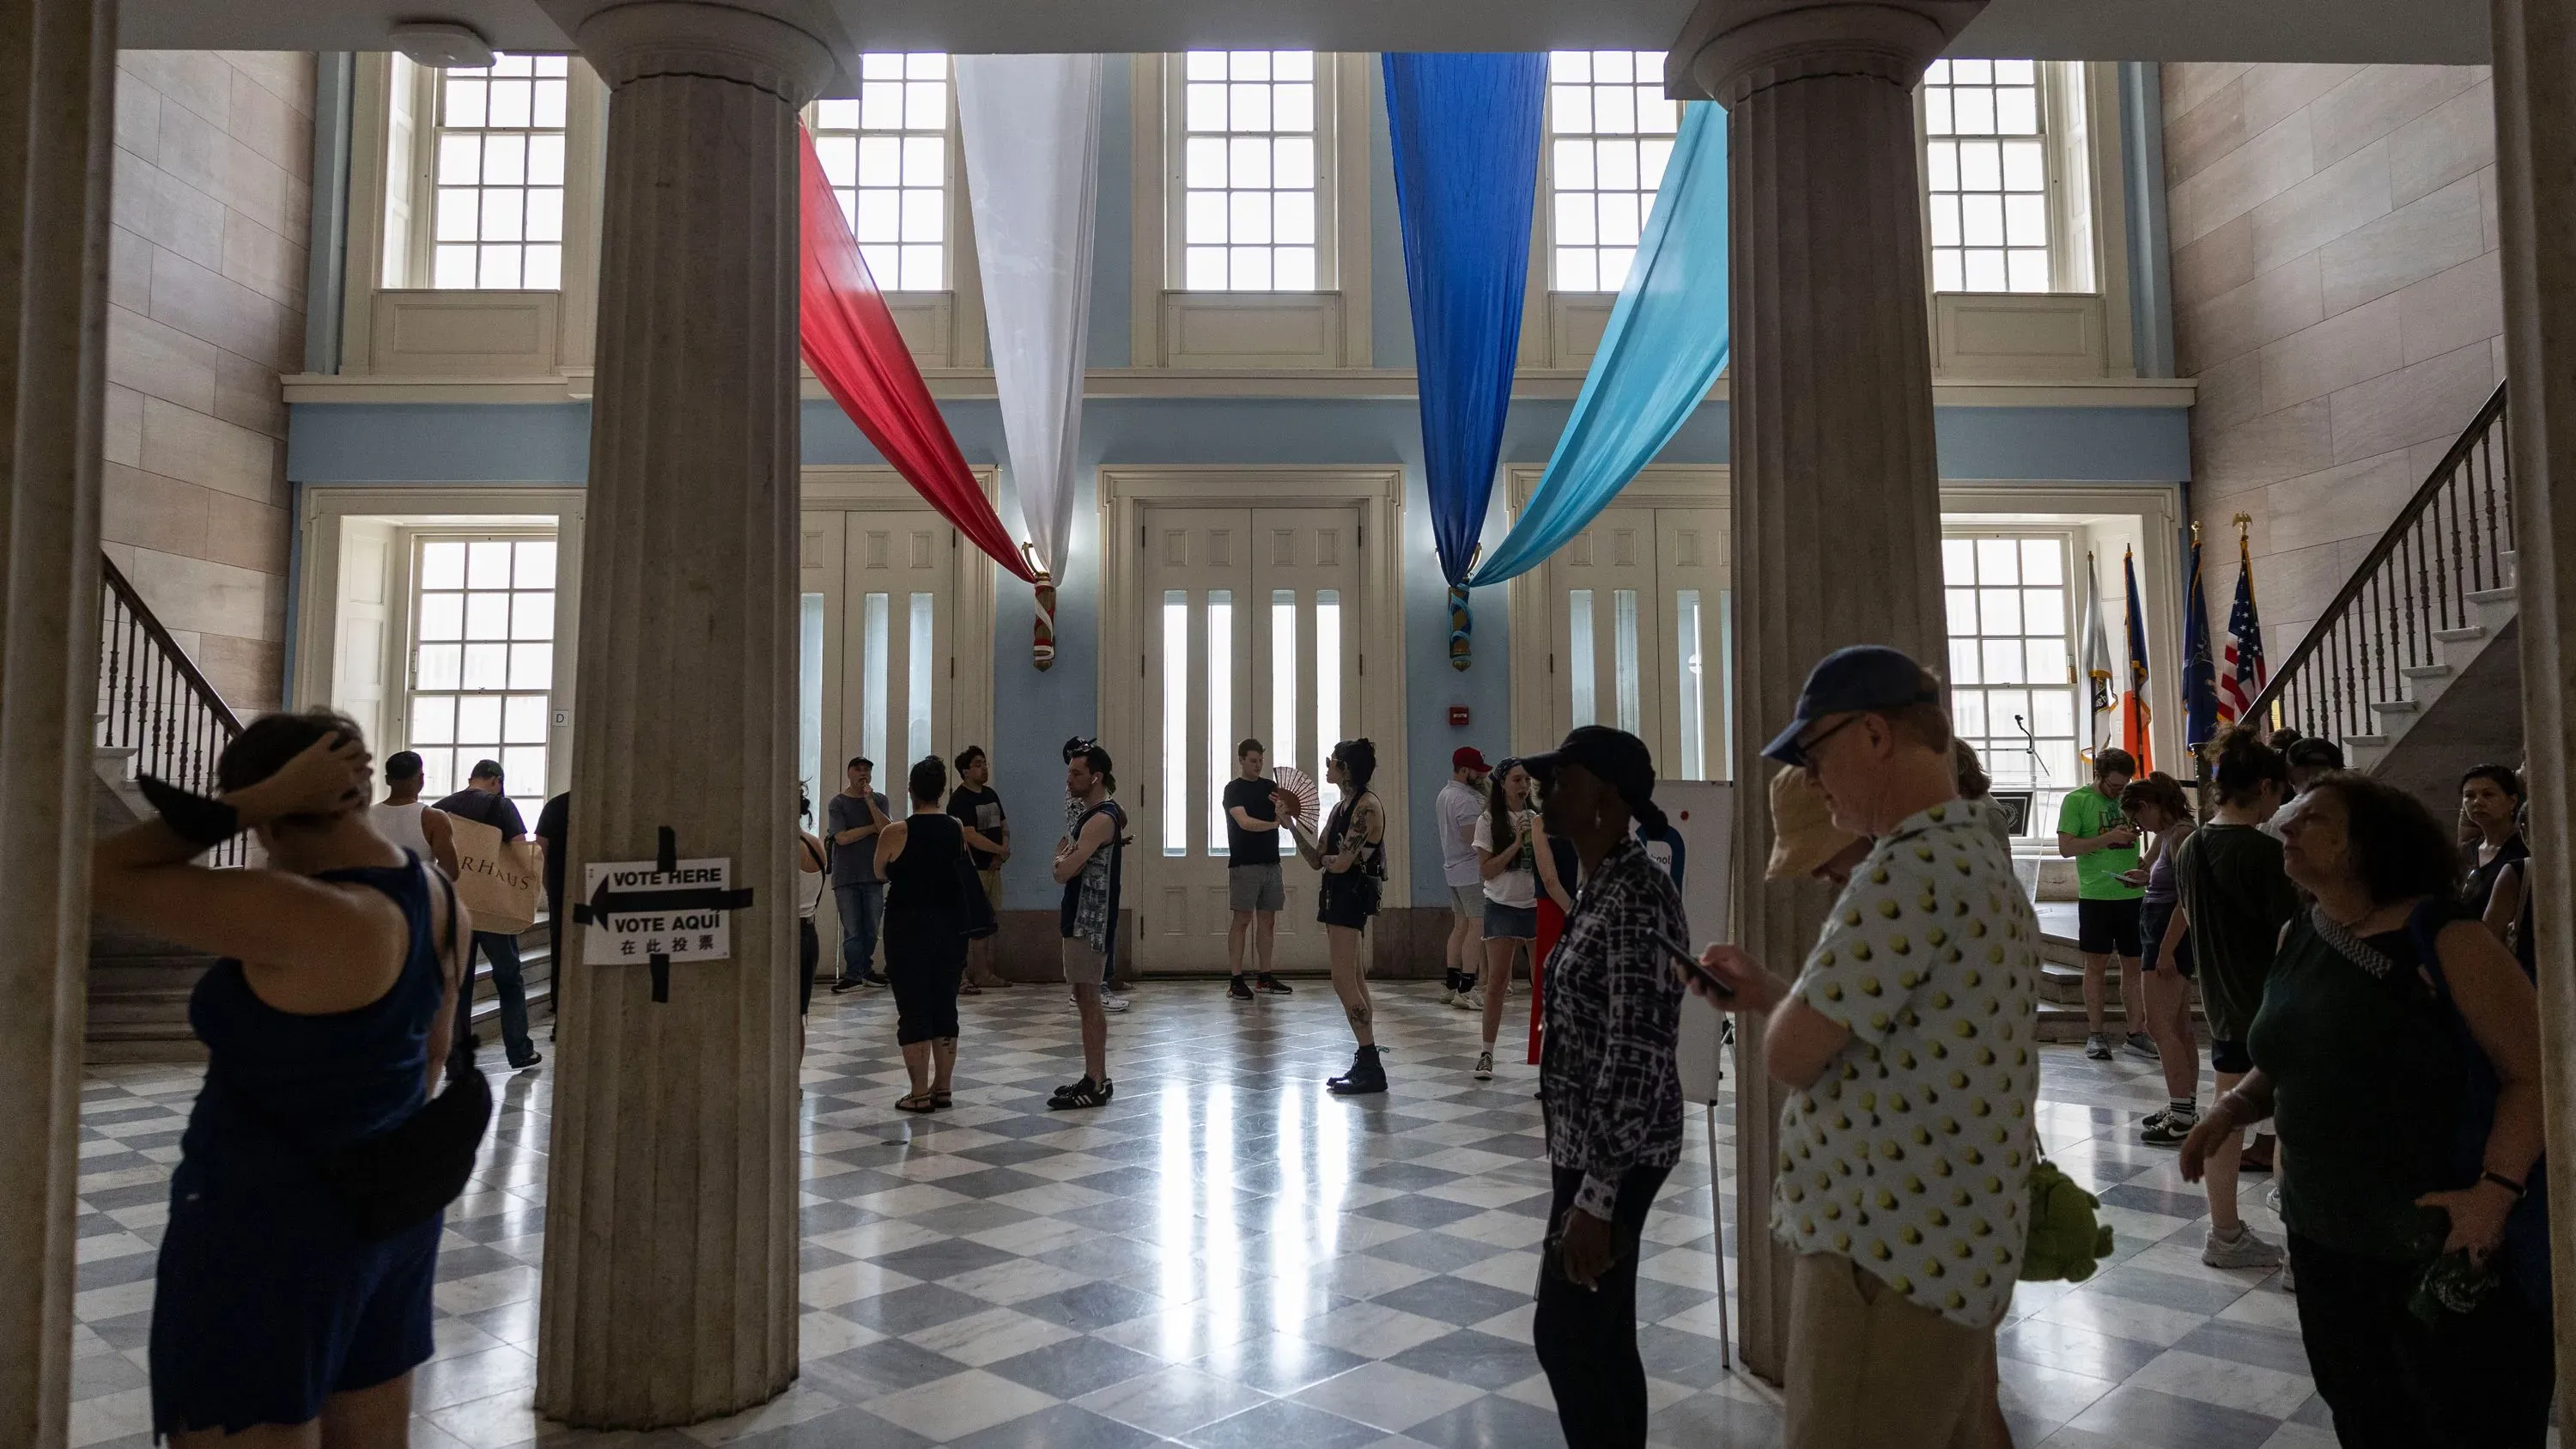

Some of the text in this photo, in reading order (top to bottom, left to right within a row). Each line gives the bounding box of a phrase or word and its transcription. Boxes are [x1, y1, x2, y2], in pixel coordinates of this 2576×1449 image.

[556, 714, 564, 722] D
[1650, 855, 1670, 864] ool
[614, 868, 721, 886] VOTE HERE
[615, 910, 720, 933] VOTE AQUÍ
[620, 935, 714, 955] 在此投票
